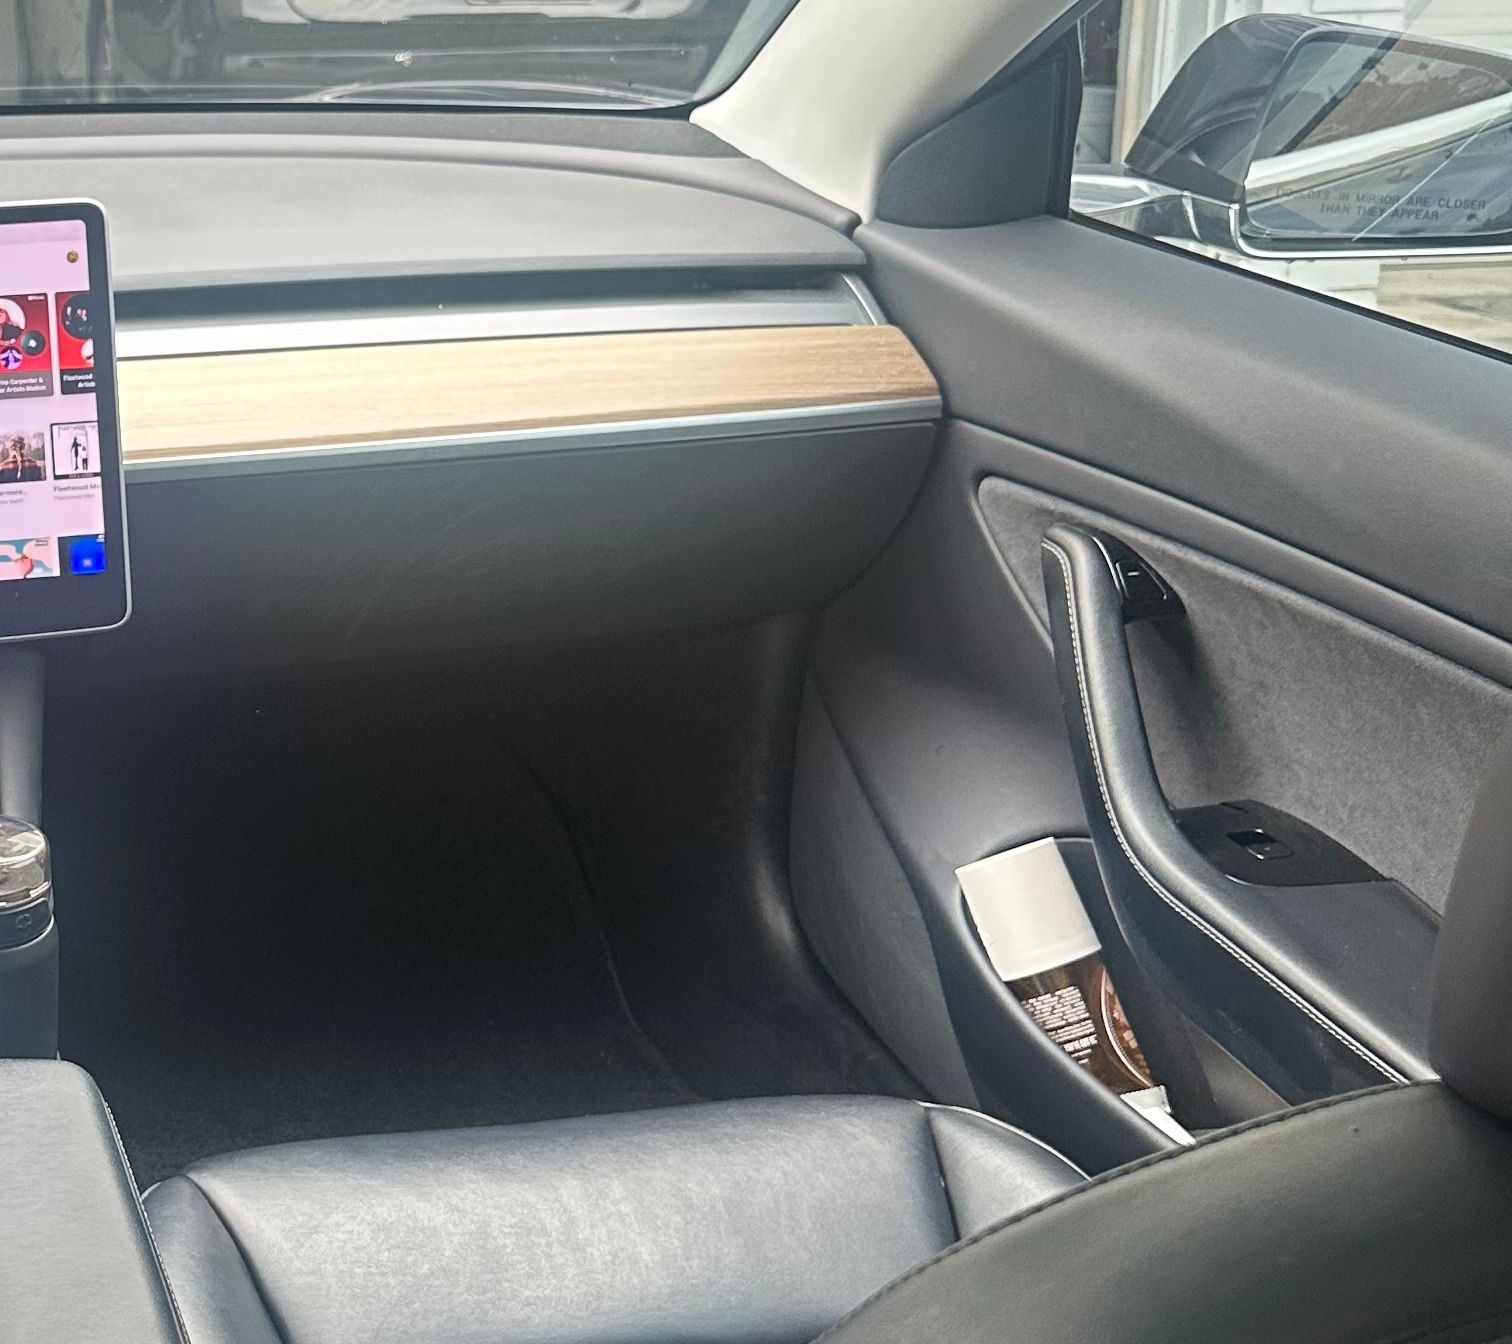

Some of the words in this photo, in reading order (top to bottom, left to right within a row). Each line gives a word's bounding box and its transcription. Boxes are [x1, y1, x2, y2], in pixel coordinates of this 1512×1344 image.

[1406, 197, 1430, 206] ARE
[1437, 199, 1486, 210] CLOSER
[1391, 209, 1439, 221] APPEAR
